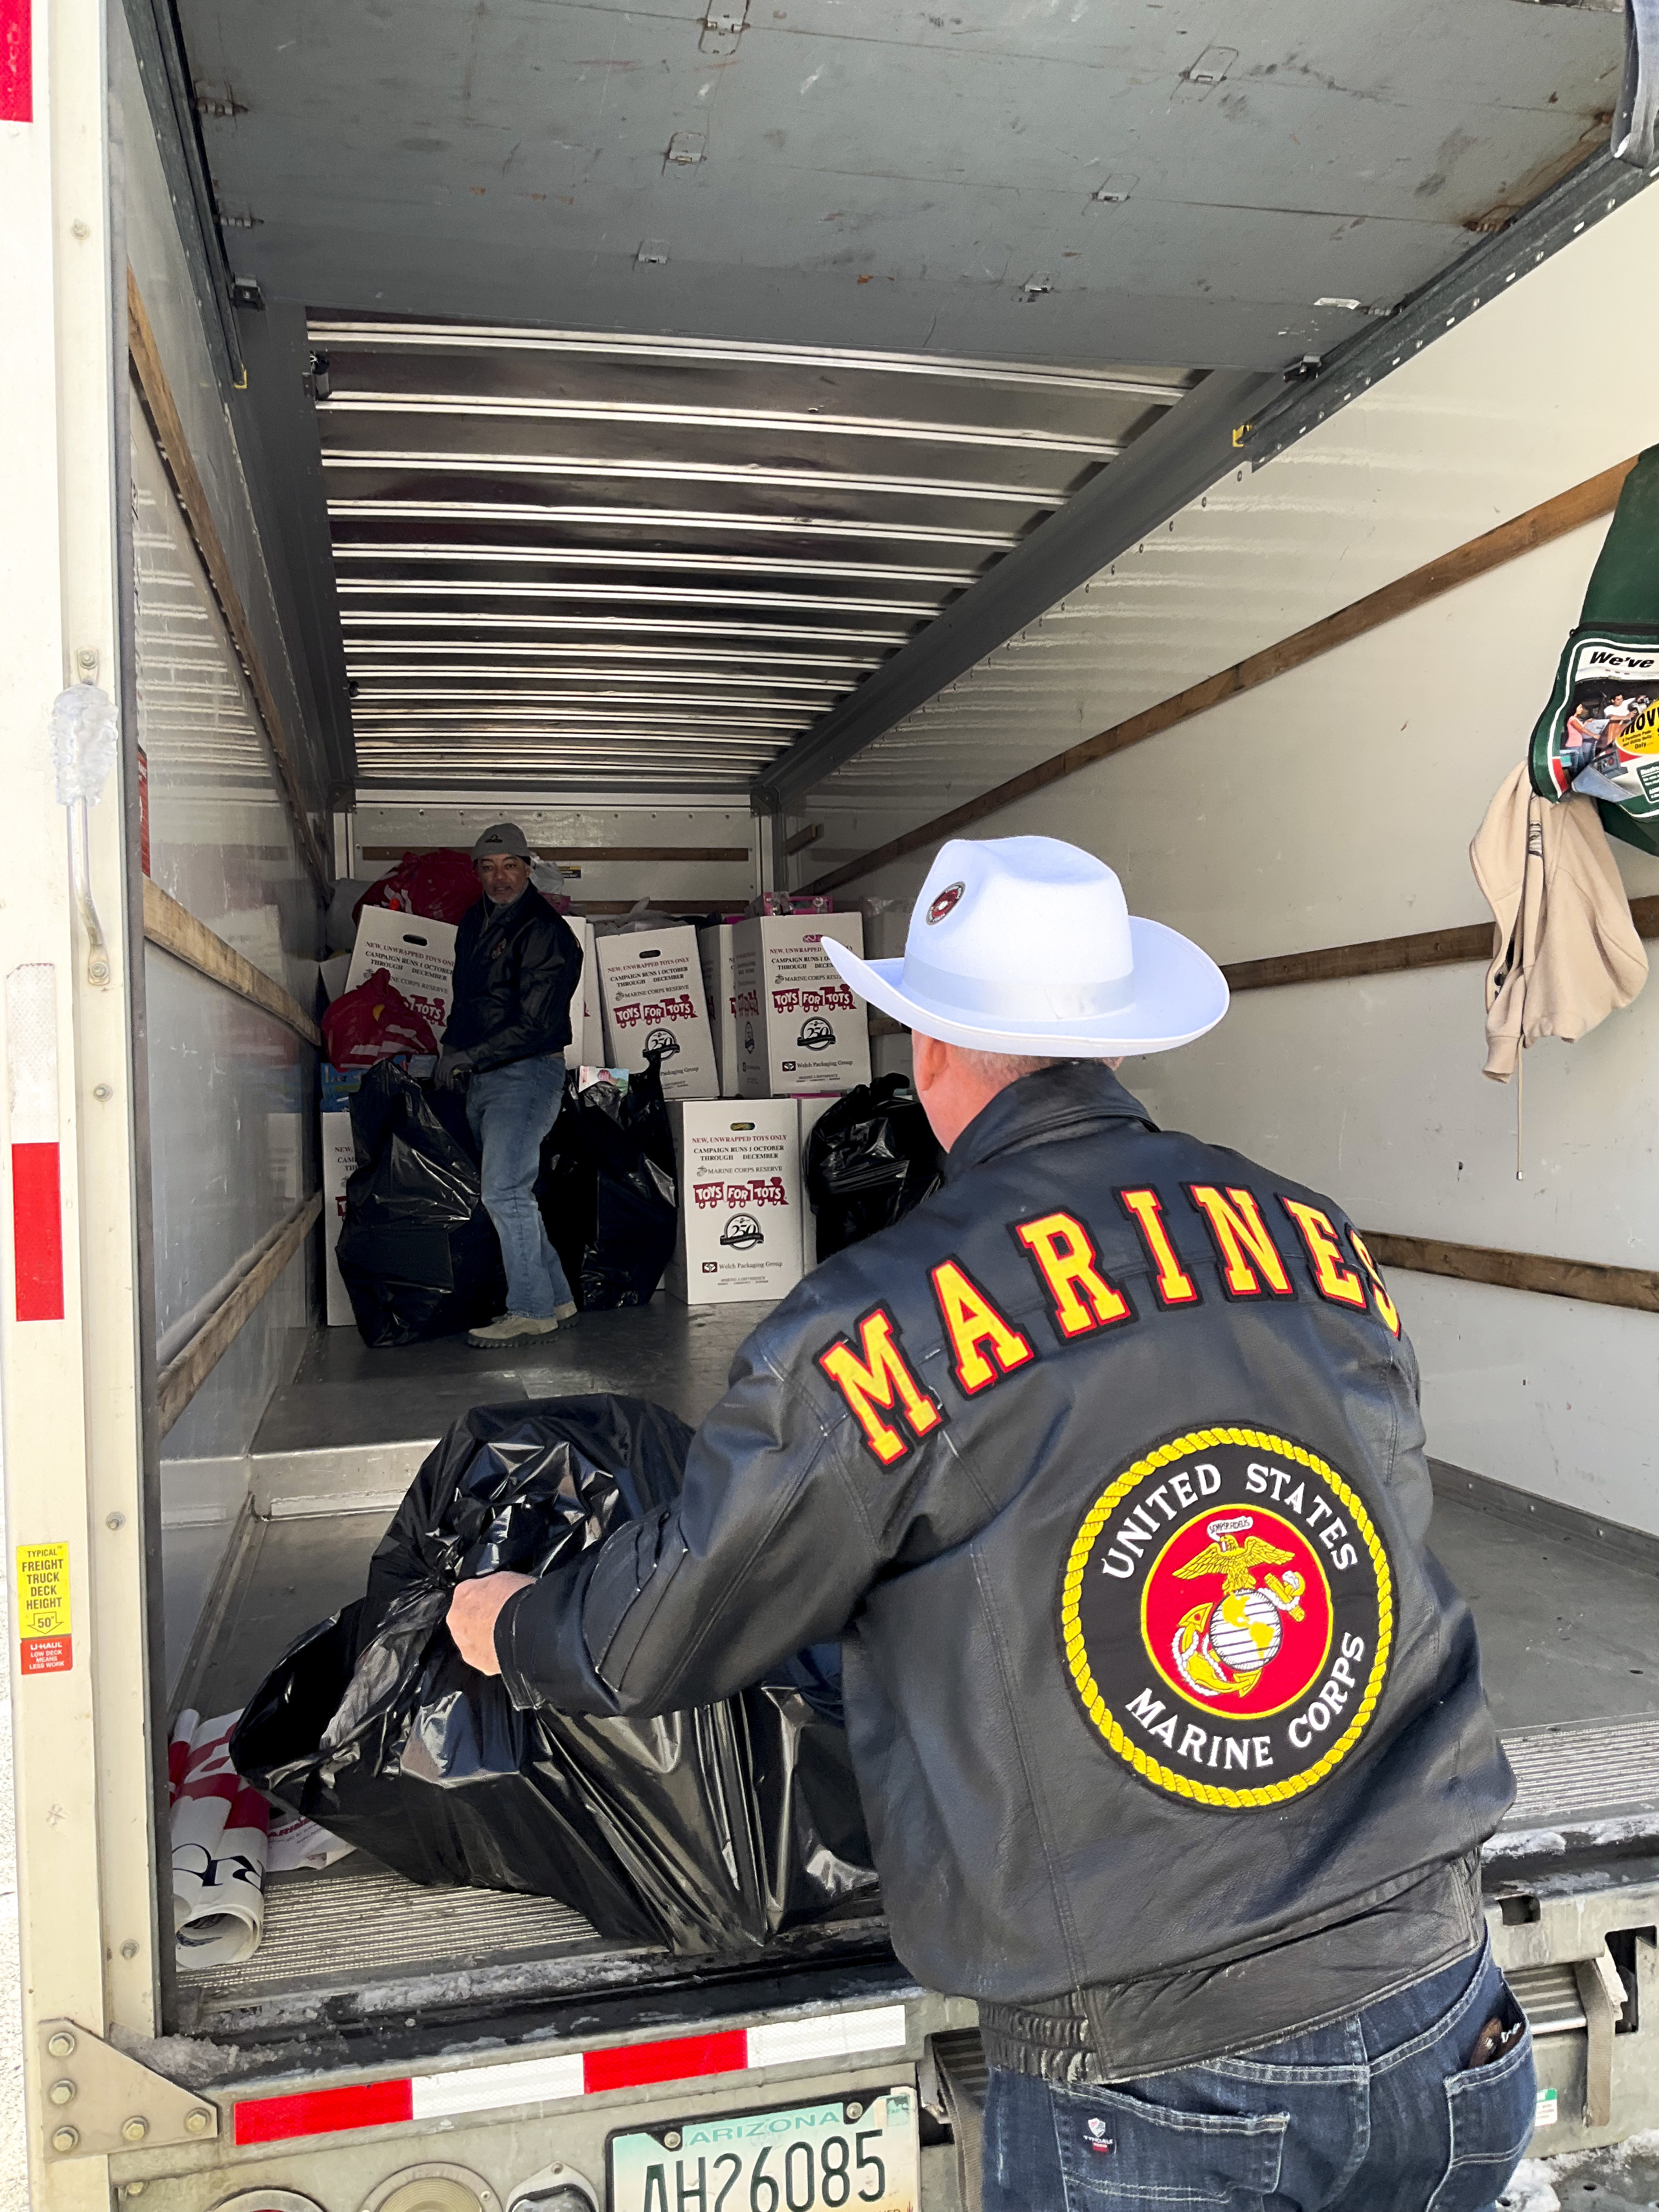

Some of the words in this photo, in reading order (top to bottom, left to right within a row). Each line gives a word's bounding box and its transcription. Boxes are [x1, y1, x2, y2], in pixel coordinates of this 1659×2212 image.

[1589, 651, 1655, 668] We've
[1620, 707, 1659, 737] MOV
[365, 951, 400, 962] CAMPAIGN
[402, 958, 419, 967] RUNS
[366, 941, 382, 950] NEW,
[384, 945, 425, 958] UNWRAPPED
[425, 955, 441, 964] TOYS
[370, 959, 404, 970] THROUGH
[411, 968, 448, 981] DECEMBER
[623, 961, 659, 971] UNWRAPPED
[610, 973, 641, 982] CAMPAIGN
[617, 979, 646, 988] THROUGH
[653, 974, 685, 983] DECEMBER
[400, 977, 420, 988] CORPS
[421, 983, 449, 994] RESERVE
[624, 990, 647, 998] MARINE
[647, 988, 665, 996] CORPS
[665, 984, 690, 992] RESERVE
[774, 992, 798, 1005] TOYS
[803, 995, 821, 1005] FOR
[826, 993, 850, 1005] TOTS
[415, 1003, 442, 1019] TOTS
[617, 1008, 640, 1020] TOYS
[645, 1007, 662, 1017] FOR
[667, 1003, 691, 1014] TOTS
[807, 1027, 828, 1039] 250
[651, 1037, 673, 1050] 250
[696, 1186, 722, 1200] TOYS
[727, 1187, 748, 1199] FOR
[754, 1187, 781, 1199] TOTS
[732, 1224, 757, 1237] 250
[819, 1183, 1401, 1466] MARINES
[1103, 1463, 1221, 1578] UNITED
[1246, 1463, 1359, 1571] STATES
[27, 1548, 57, 1558] TYPICAL
[22, 1559, 64, 1572] FREIGHT
[26, 1572, 60, 1584] TRUCK
[31, 1585, 57, 1597] DECK
[26, 1597, 63, 1610] HEIGHT
[37, 1616, 55, 1628] 50"
[30, 1641, 63, 1650] U-HAUL
[1125, 1688, 1273, 1770] MARINE
[1289, 1632, 1365, 1748] CORPS
[689, 2111, 840, 2146] ARIZONA
[644, 2129, 885, 2212] AH26085
